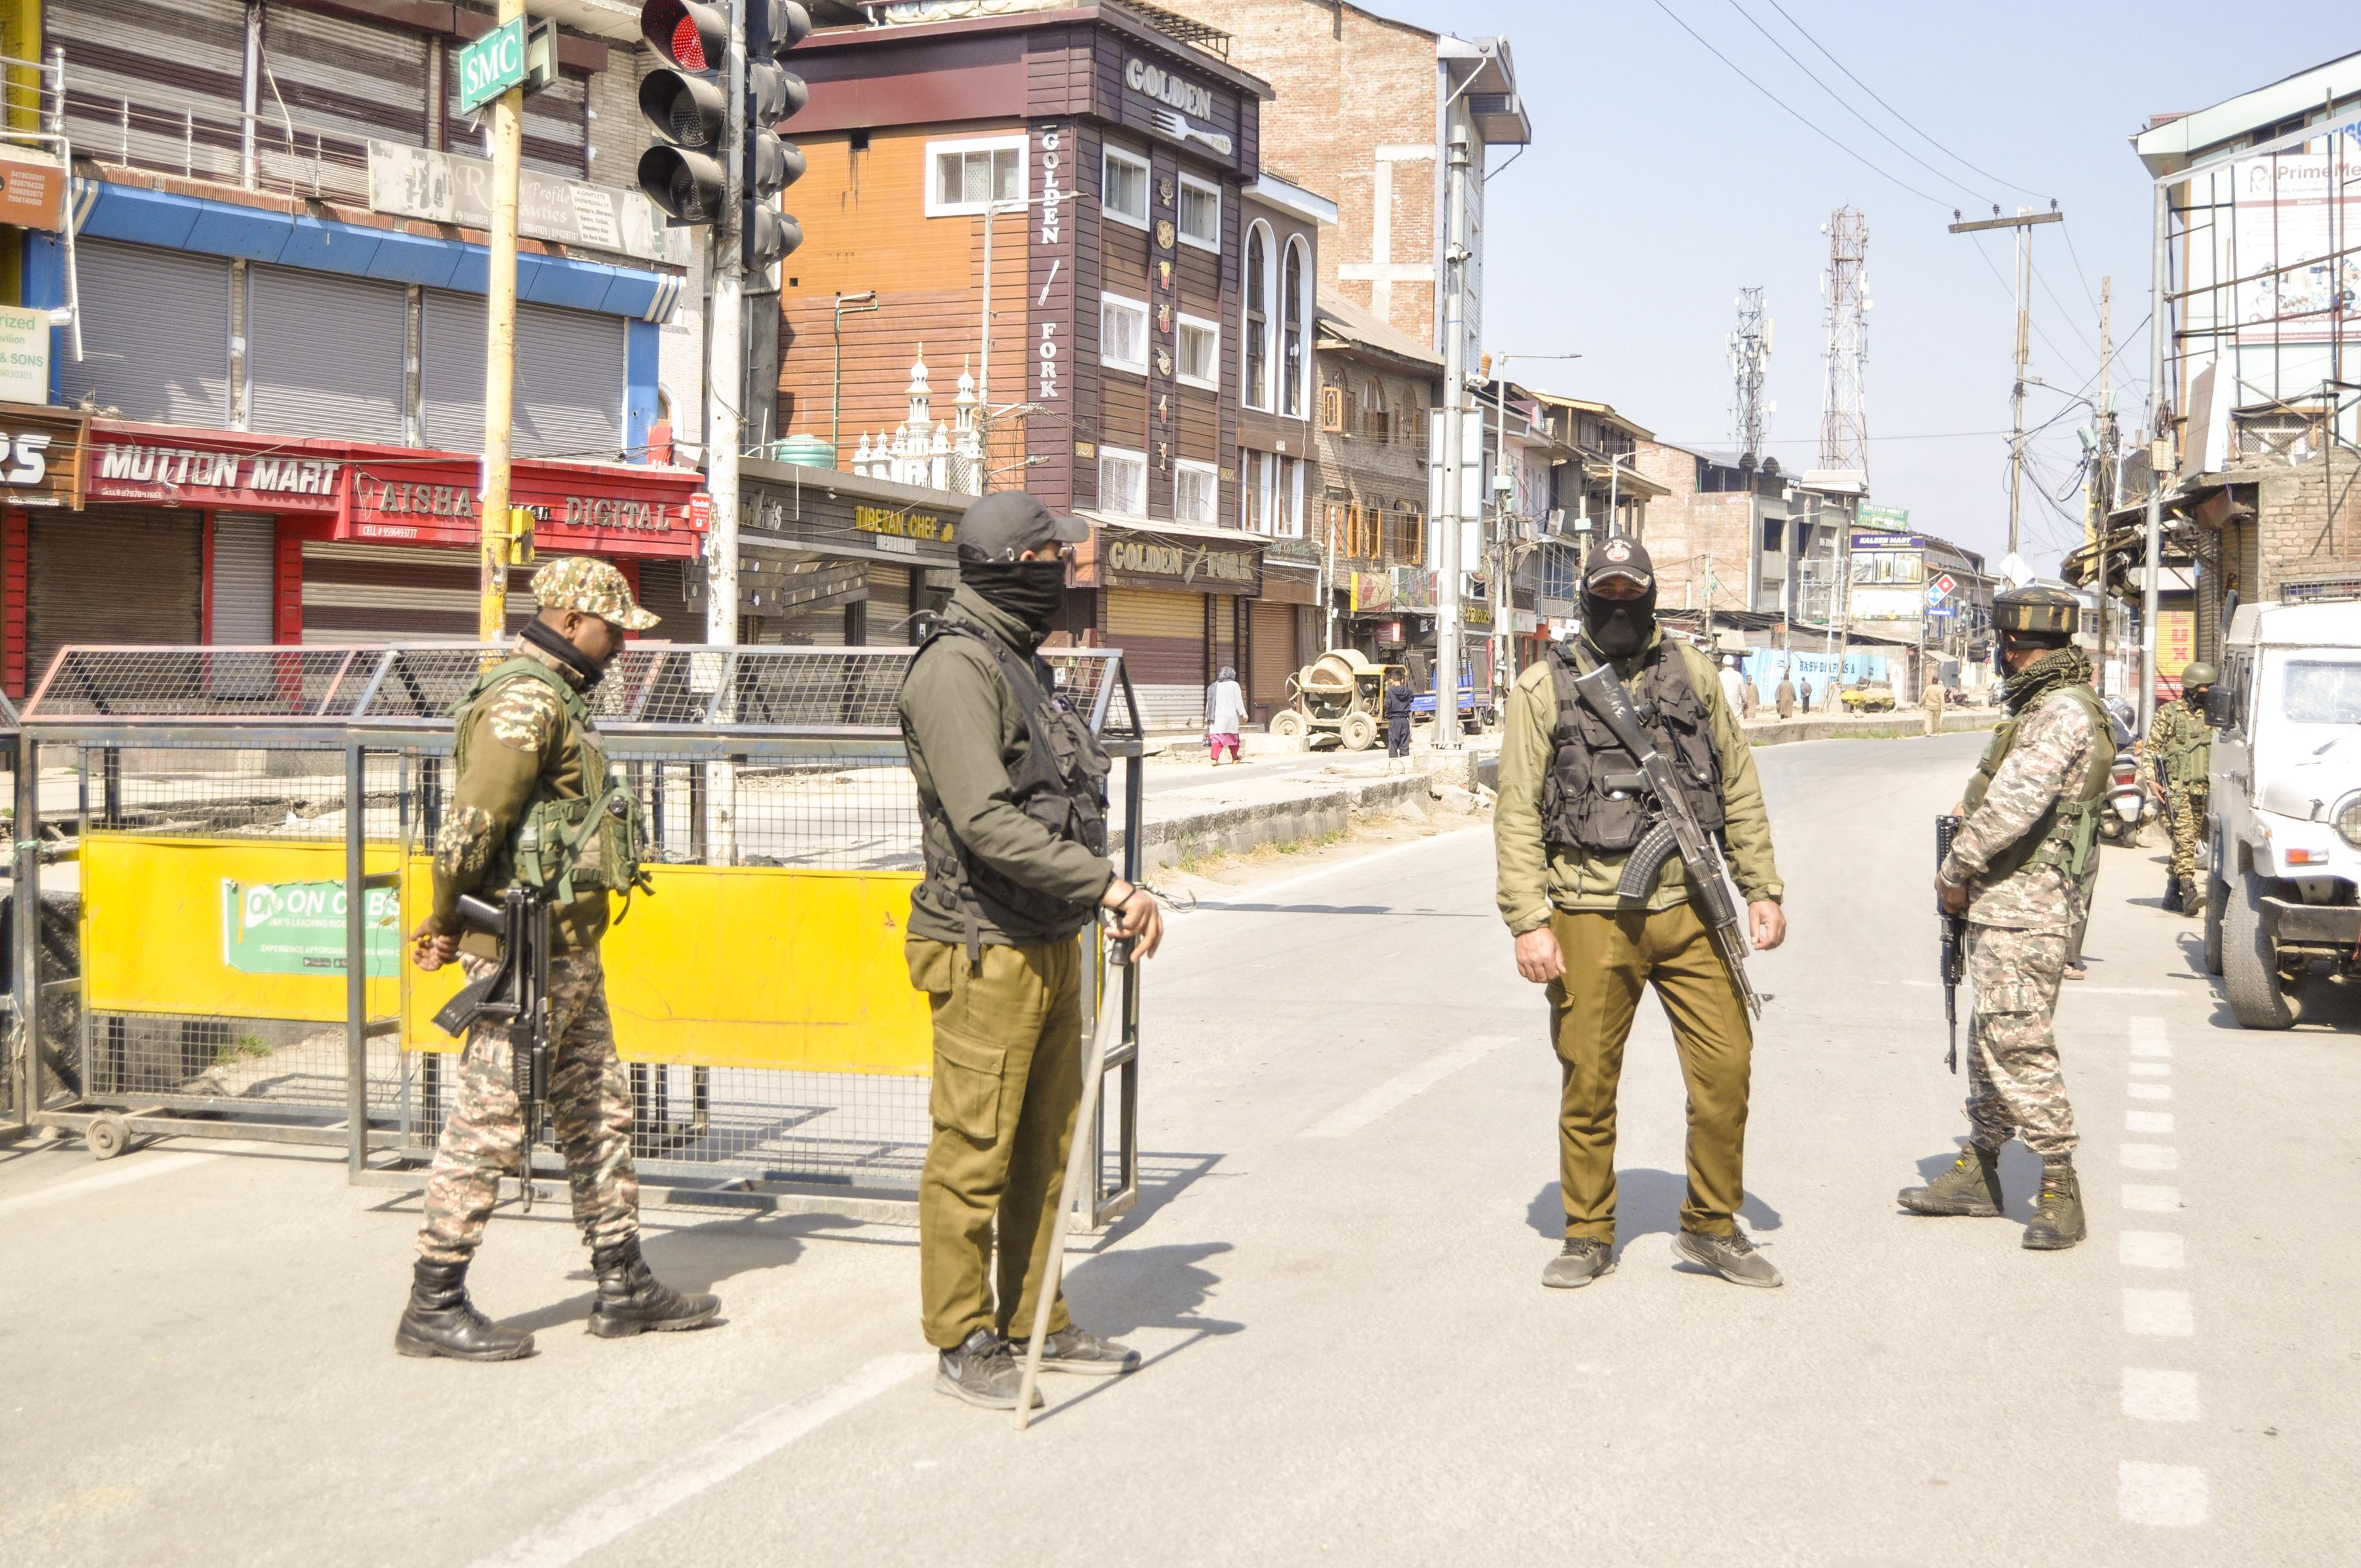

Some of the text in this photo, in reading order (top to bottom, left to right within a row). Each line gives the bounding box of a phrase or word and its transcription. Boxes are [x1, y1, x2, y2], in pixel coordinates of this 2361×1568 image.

[467, 34, 517, 95] SMC
[1126, 58, 1212, 121] GOLDEN
[529, 181, 571, 205] Profile
[1040, 133, 1061, 398] GOLDEN FORK
[11, 354, 43, 366] SONS
[102, 443, 339, 494] MUTTON MART
[379, 482, 473, 517] AISHA
[565, 497, 671, 531] DIGITAL
[692, 499, 710, 508] Kodak
[1886, 507, 1905, 516] MART
[363, 526, 377, 536] CELL
[854, 505, 938, 539] TIBETAN CHEF
[1109, 541, 1253, 580] GOLDEN FORK
[1800, 660, 1817, 672] BABY
[287, 890, 325, 915] ON
[333, 891, 400, 916] CBS
[261, 944, 304, 953] EXPERIENCE
